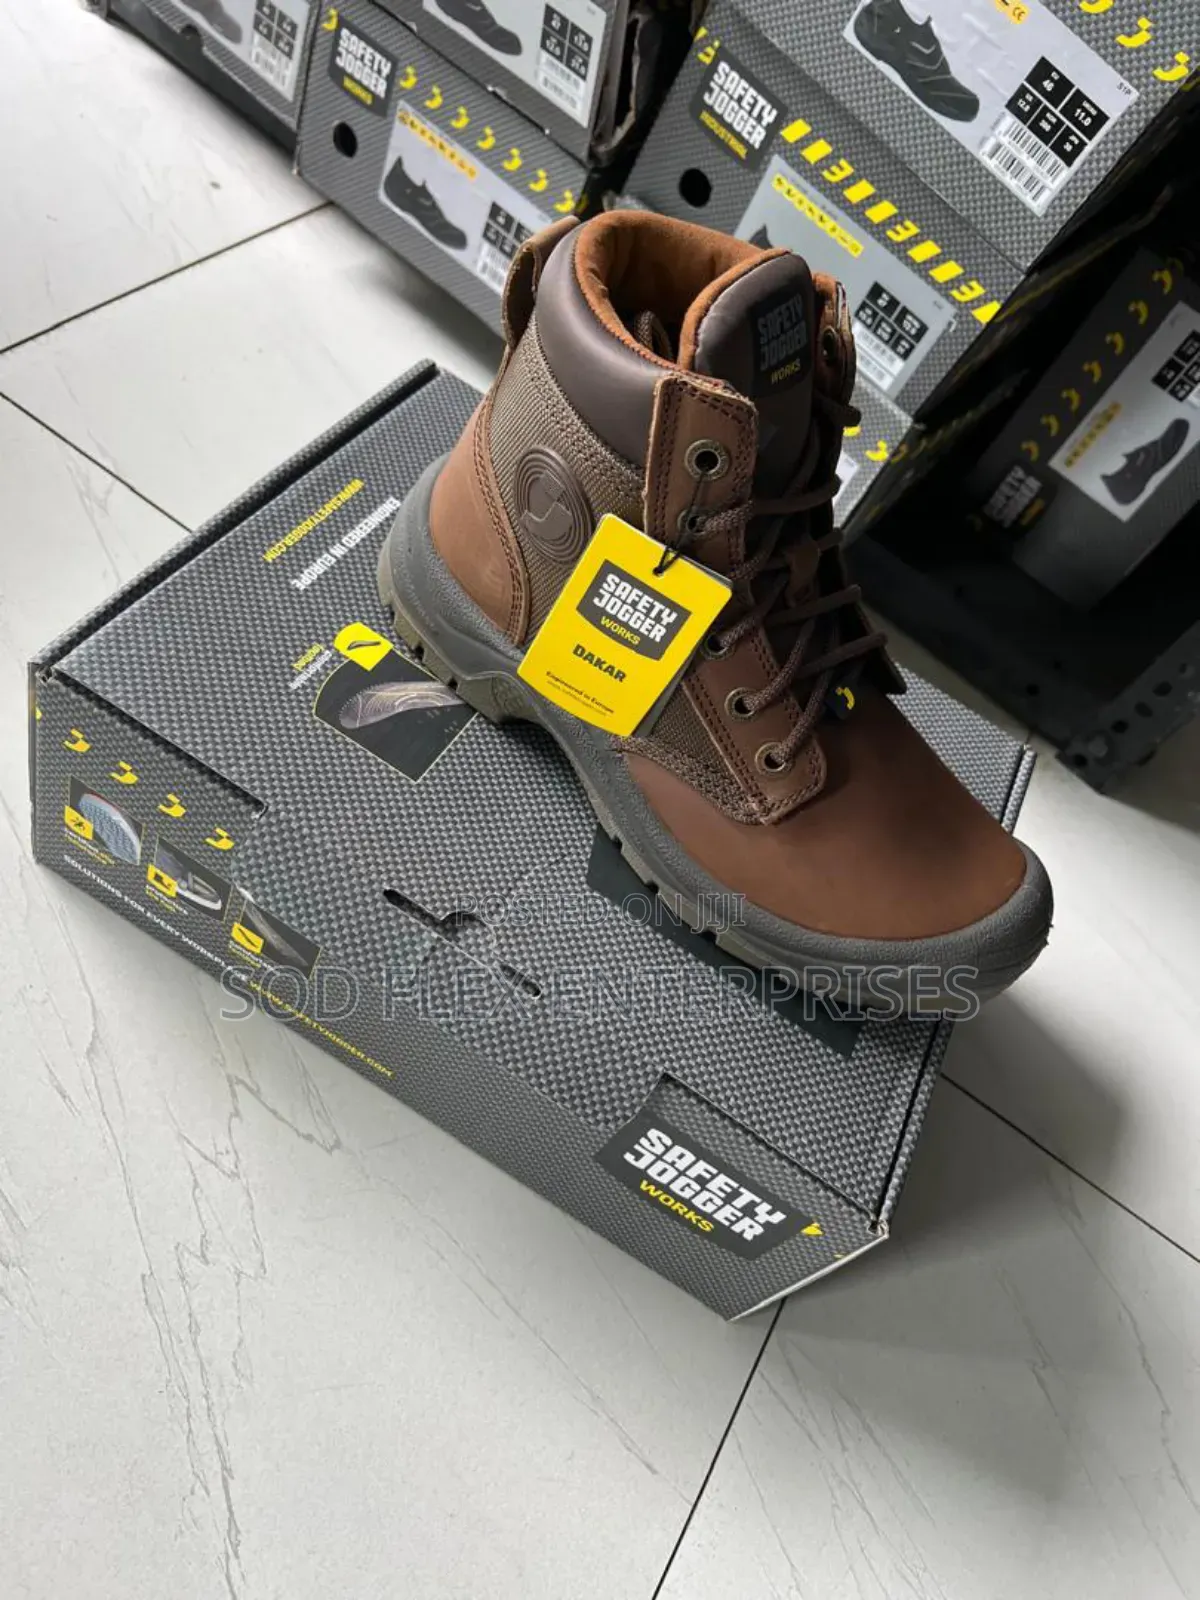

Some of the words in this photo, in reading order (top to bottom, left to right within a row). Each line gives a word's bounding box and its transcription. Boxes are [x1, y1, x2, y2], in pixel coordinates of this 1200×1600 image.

[335, 46, 387, 98] JOGGER
[339, 27, 392, 78] SAFETY
[703, 81, 767, 149] JOGGER
[713, 61, 778, 127] SAFETY
[1074, 108, 1092, 126] 11.0
[341, 496, 402, 548] ENGINEERED
[290, 552, 336, 591] EUROPE
[593, 590, 667, 643] JOGGER
[602, 573, 678, 625] SAFETY
[601, 616, 641, 645] WORKS
[572, 643, 627, 683] DAKAR
[623, 1144, 764, 1241] JOGGER
[641, 1128, 786, 1225] SAFETY
[639, 1179, 715, 1233] WORKS
